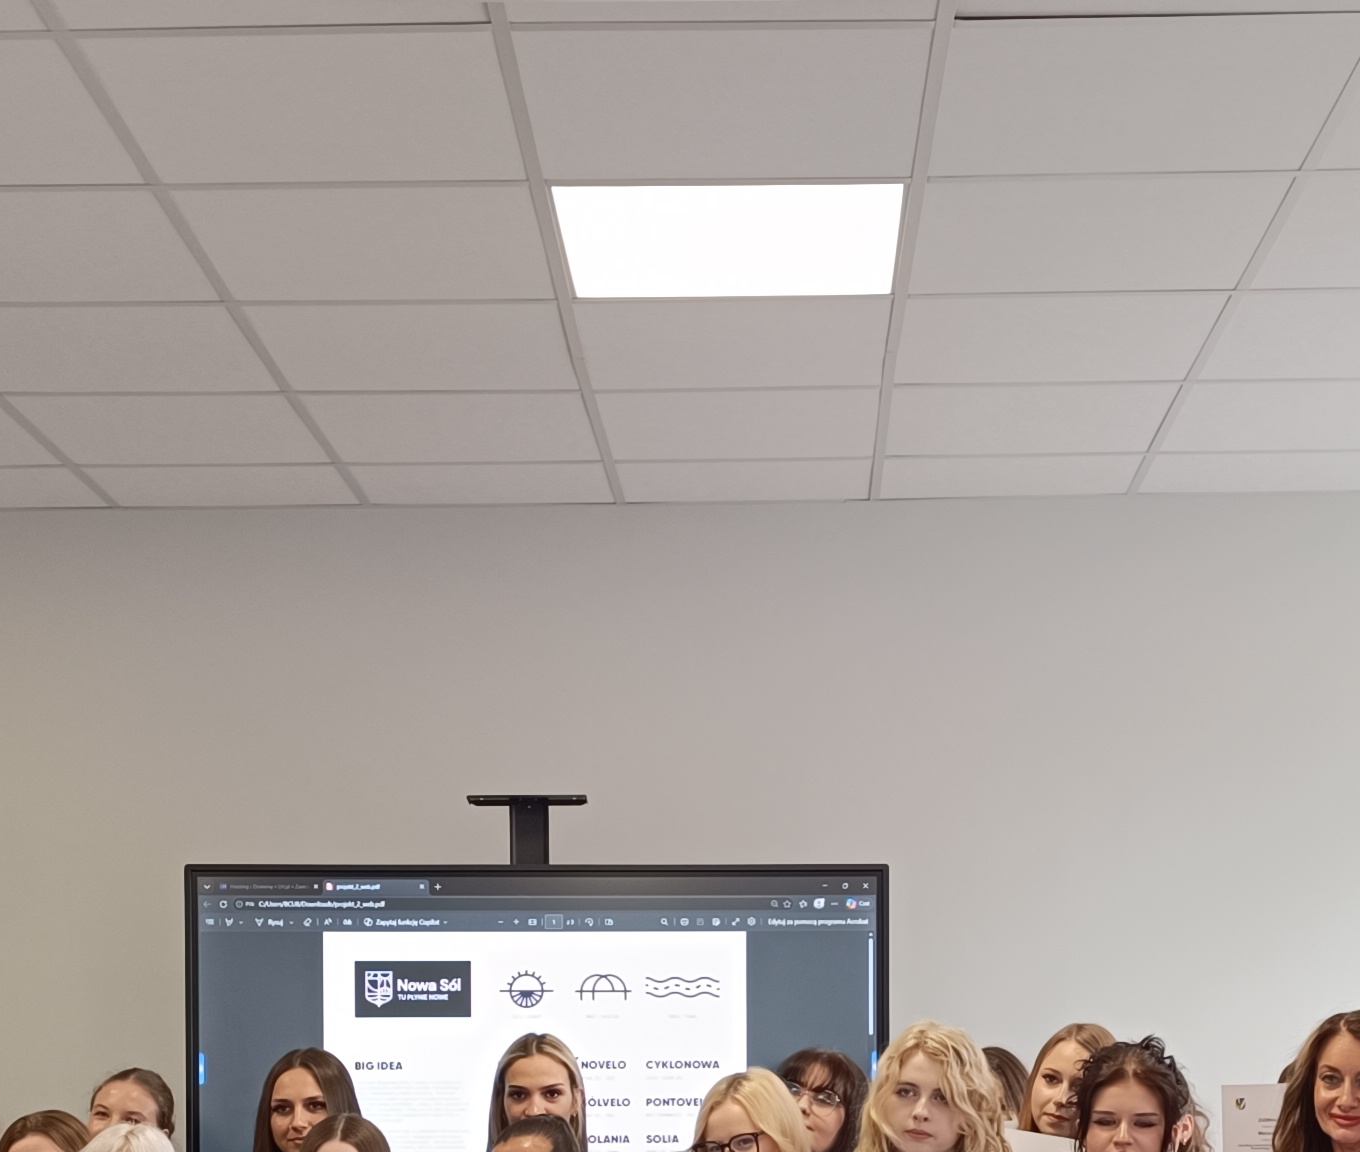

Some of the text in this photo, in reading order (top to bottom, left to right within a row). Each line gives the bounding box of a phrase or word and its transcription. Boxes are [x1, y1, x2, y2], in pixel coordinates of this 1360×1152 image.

[397, 978, 461, 992] Nowa Sól
[355, 1061, 403, 1070] BIG IDEA
[581, 1060, 627, 1070] NOVELO
[646, 1060, 720, 1069] CYKLONOWA
[587, 1096, 631, 1107] ÓLVELO
[587, 1135, 630, 1144] OLANIA
[646, 1135, 679, 1144] SOLIA
